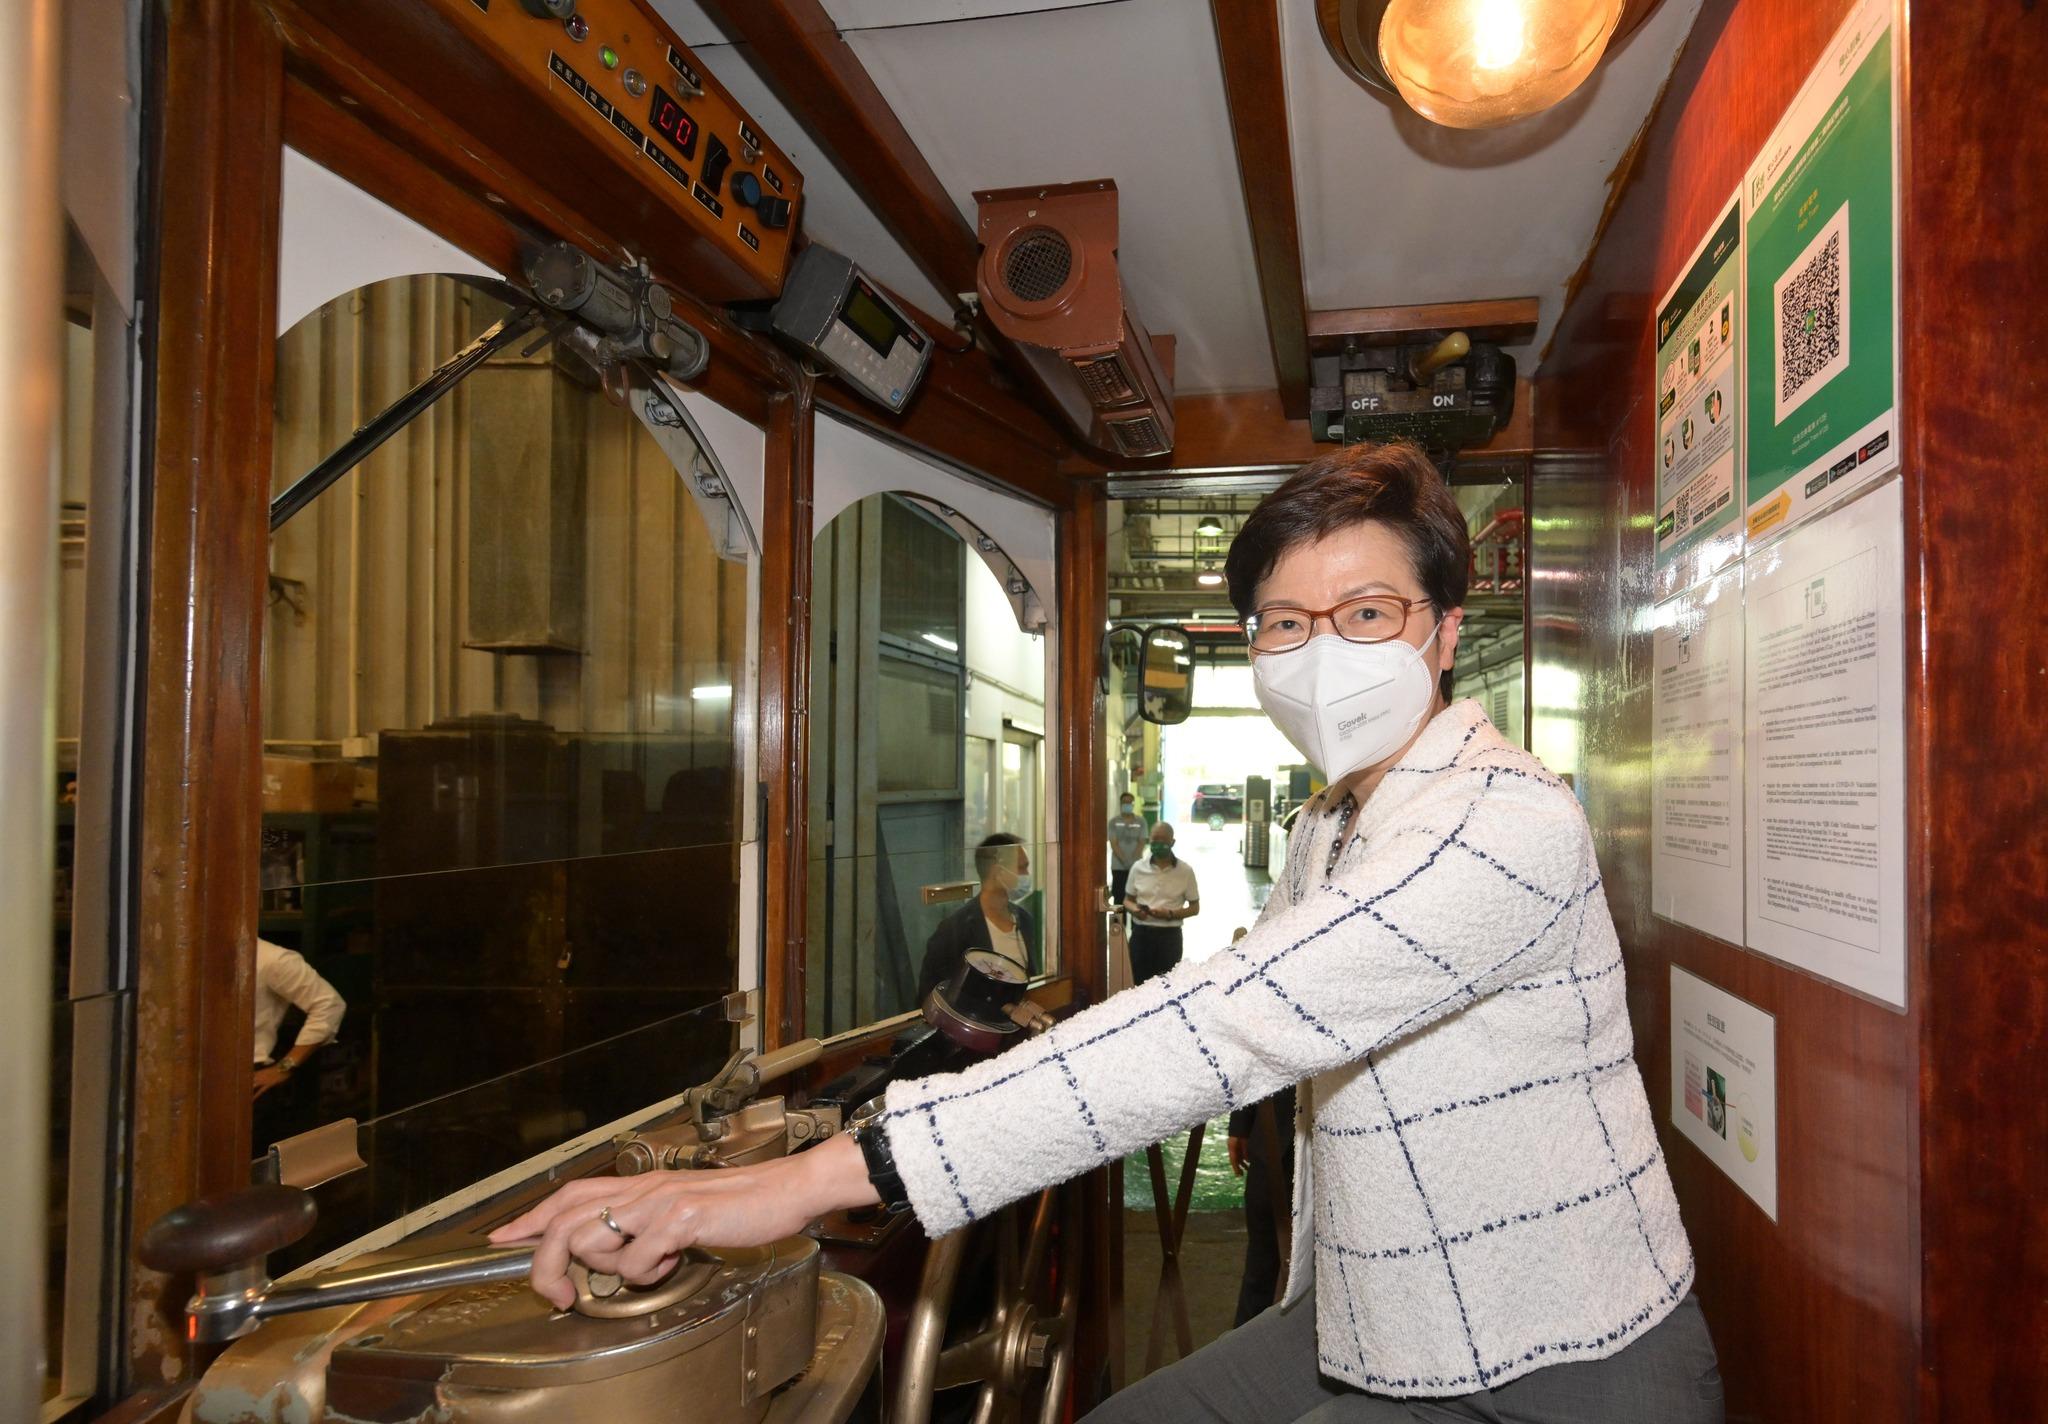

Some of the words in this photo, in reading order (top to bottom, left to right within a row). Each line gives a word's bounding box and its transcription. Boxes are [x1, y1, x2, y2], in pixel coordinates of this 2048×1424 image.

[1709, 319, 1714, 335] 2
[1352, 398, 1378, 410] OFF
[1433, 394, 1454, 407] ON
